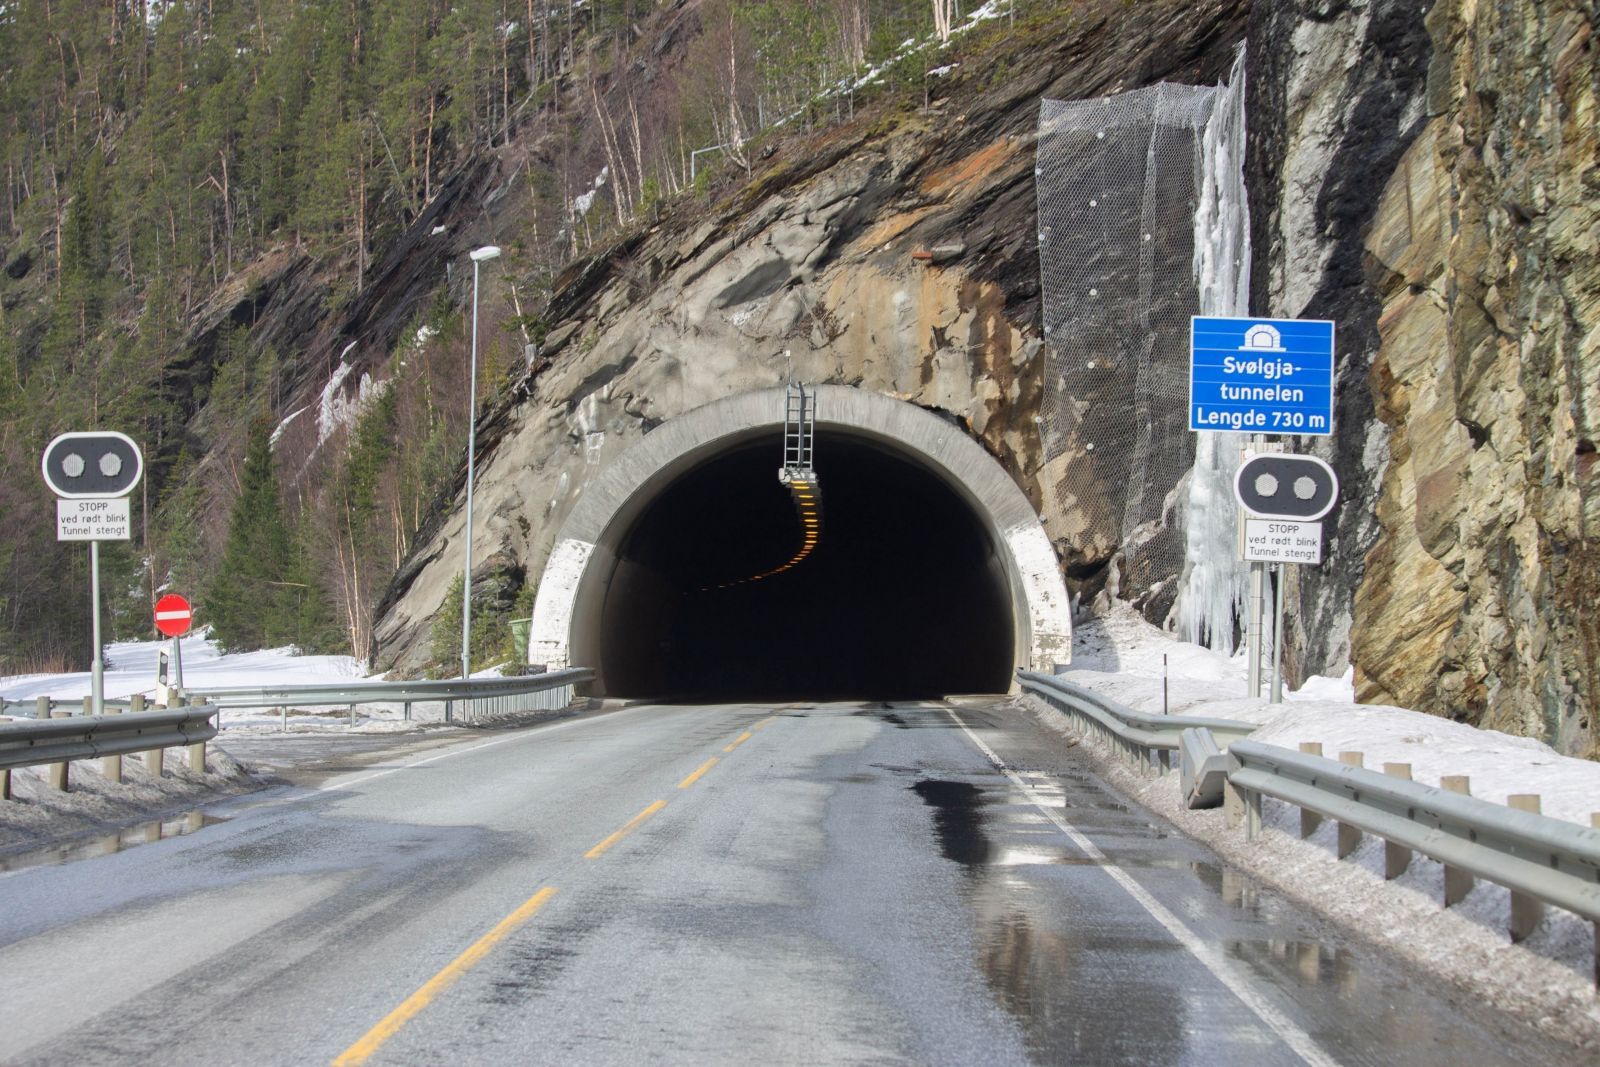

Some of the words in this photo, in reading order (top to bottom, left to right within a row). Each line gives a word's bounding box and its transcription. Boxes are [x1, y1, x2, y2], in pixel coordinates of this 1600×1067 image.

[1223, 356, 1302, 380] Svølgja-
[1220, 384, 1304, 402] tunnelen
[1197, 407, 1266, 429] Lengde
[1272, 412, 1304, 428] 730
[1308, 414, 1325, 428] m
[78, 502, 108, 512] STOPP
[60, 514, 78, 524] ved
[82, 515, 101, 523] rødt
[106, 514, 127, 523] blink
[62, 526, 91, 535] Tunnel
[96, 526, 126, 536] stengt
[1268, 524, 1300, 534] STOPP
[1248, 536, 1266, 544] ved
[1271, 537, 1292, 546] rødt
[1296, 537, 1318, 547] blink
[1249, 546, 1280, 556] Tunnel
[1284, 550, 1316, 560] stengt
